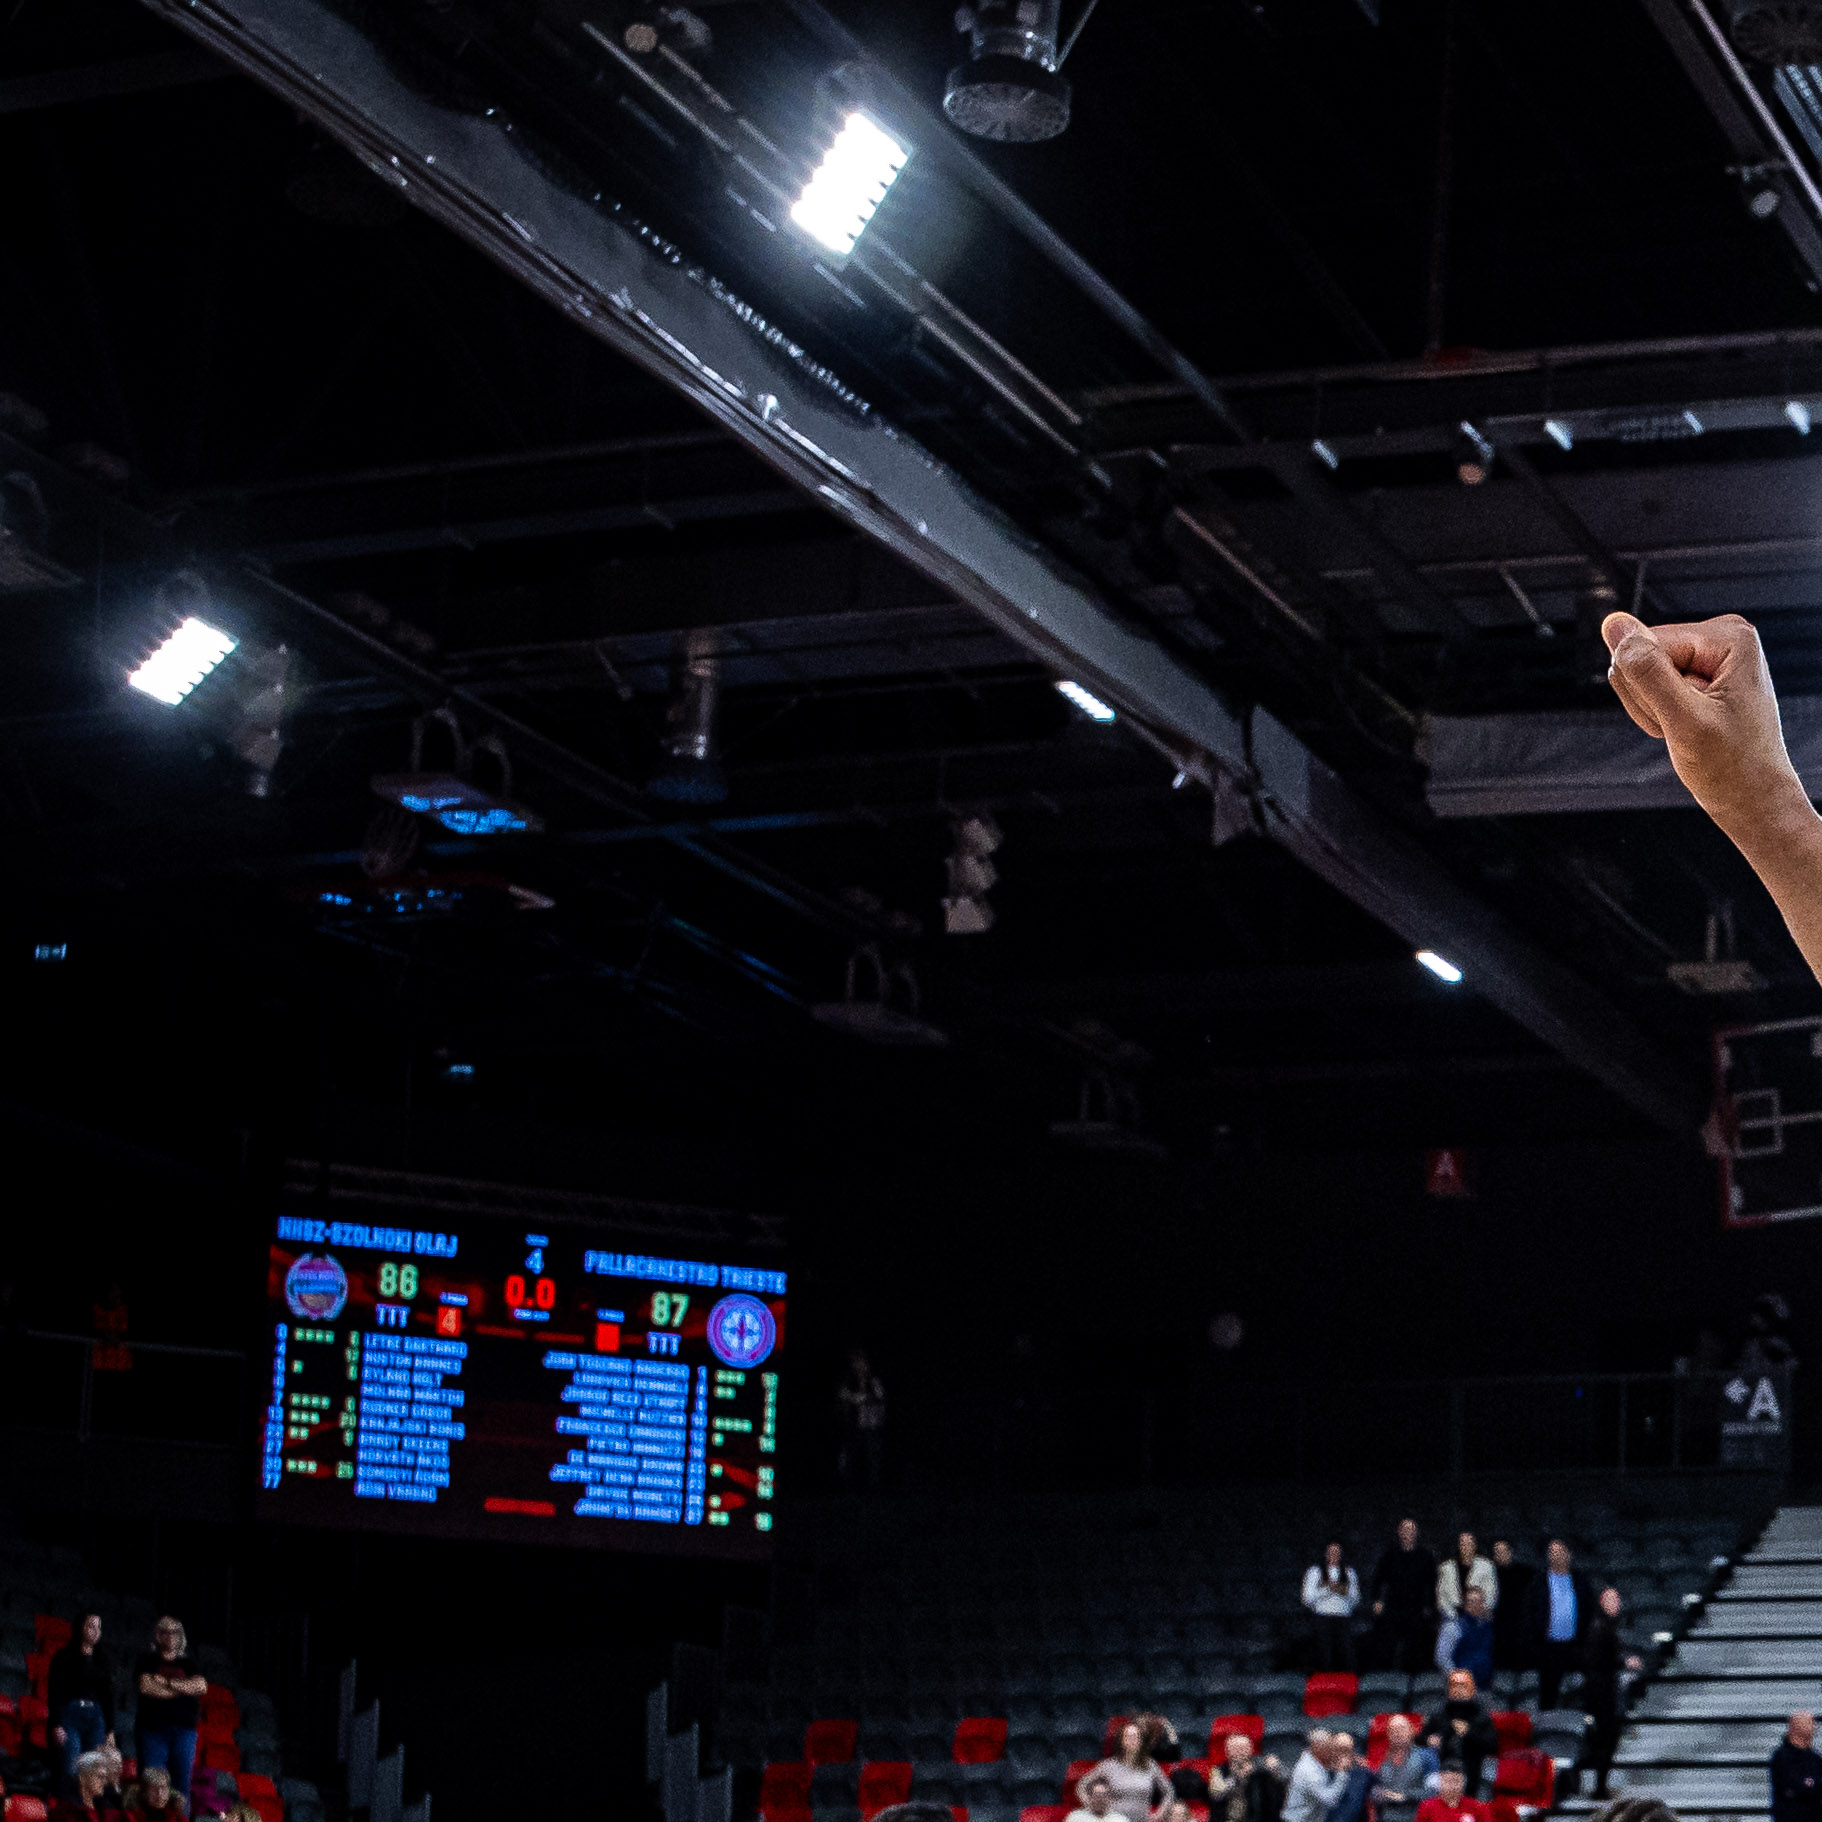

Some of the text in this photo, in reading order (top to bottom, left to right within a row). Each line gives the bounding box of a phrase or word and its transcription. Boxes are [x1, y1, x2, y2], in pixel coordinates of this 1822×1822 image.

[413, 1231, 459, 1258] OLAJ
[650, 1290, 690, 1328] 87
[1747, 1376, 1782, 1421] A
